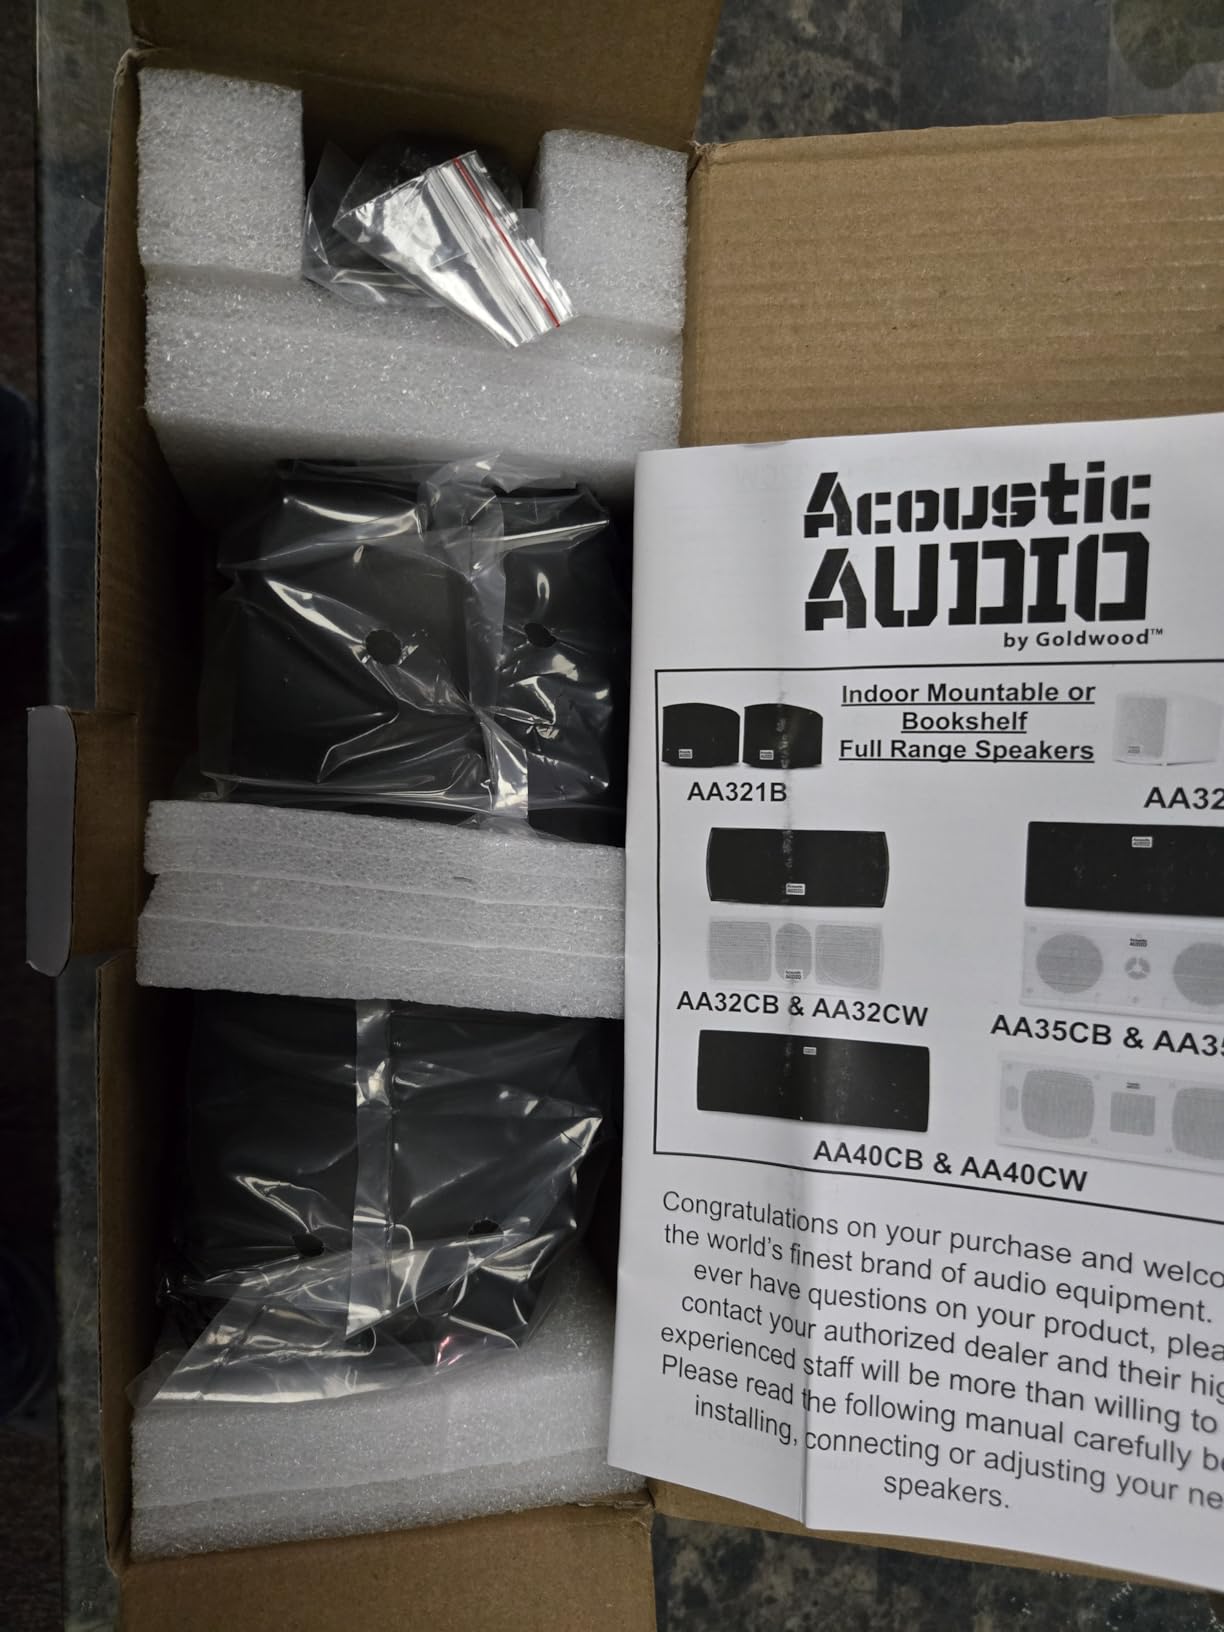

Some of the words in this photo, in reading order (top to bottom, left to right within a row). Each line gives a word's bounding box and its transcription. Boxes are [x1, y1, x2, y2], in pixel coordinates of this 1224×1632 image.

[804, 461, 1151, 538] Acoustic
[805, 532, 1150, 630] AUDIO
[1003, 632, 1029, 651] by
[841, 684, 919, 704] Indoor
[928, 682, 1058, 703] Mountable
[1066, 685, 1095, 702] or
[902, 711, 1028, 731] Bookshelf
[839, 740, 882, 759] Full
[891, 740, 967, 763] Range
[975, 740, 1095, 763] Speakers
[686, 782, 788, 802] AA321B
[677, 991, 780, 1014] AA32CB
[788, 996, 805, 1015] &
[813, 1000, 928, 1027] AA32CW
[991, 1015, 1112, 1046] AA35CB
[1123, 1026, 1144, 1050] &
[1152, 1030, 1224, 1057] AA3
[814, 1141, 923, 1171] AA40CB
[934, 1153, 952, 1174] &
[961, 1156, 1087, 1191] AA40CW
[663, 1191, 838, 1235] Congratulations
[848, 1220, 876, 1238] on
[886, 1224, 942, 1246] your
[950, 1232, 1072, 1264] purchase
[1082, 1252, 1132, 1274] and
[1144, 1260, 1224, 1288] welco
[664, 1224, 699, 1246] the
[790, 1242, 852, 1272] finest
[862, 1251, 932, 1280] brand
[942, 1262, 967, 1284] of
[974, 1270, 1046, 1296] audio
[1056, 1283, 1212, 1323] equipment.
[682, 1296, 762, 1326] contact
[770, 1312, 816, 1339] your
[824, 1322, 954, 1354] authorized
[965, 1336, 1048, 1368] dealer
[1058, 1354, 1108, 1378] and
[1118, 1360, 1182, 1390] their
[694, 1264, 742, 1286] ever
[750, 1268, 800, 1300] have
[808, 1288, 926, 1314] questions
[936, 1300, 966, 1320] on
[977, 1306, 1036, 1329] your
[1044, 1316, 1154, 1354] product,
[1168, 1334, 1224, 1360] plea
[661, 1327, 796, 1370] experienced
[803, 1356, 854, 1378] staff
[861, 1360, 899, 1383] will
[910, 1362, 940, 1388] be
[950, 1374, 1016, 1399] more
[1026, 1380, 1084, 1411] than
[1094, 1395, 1180, 1432] willing
[1191, 1409, 1218, 1434] to
[662, 1354, 738, 1388] Please
[746, 1376, 793, 1405] read
[803, 1387, 837, 1416] the
[845, 1392, 955, 1432] following
[966, 1412, 1063, 1444] manual
[1074, 1430, 1192, 1472] carefully
[1203, 1446, 1224, 1471] b
[696, 1394, 797, 1446] installing,
[804, 1430, 939, 1467] connecting
[950, 1447, 976, 1466] or
[984, 1450, 1105, 1493] adjusting
[1116, 1474, 1178, 1500] your
[884, 1476, 1008, 1508] speakers.
